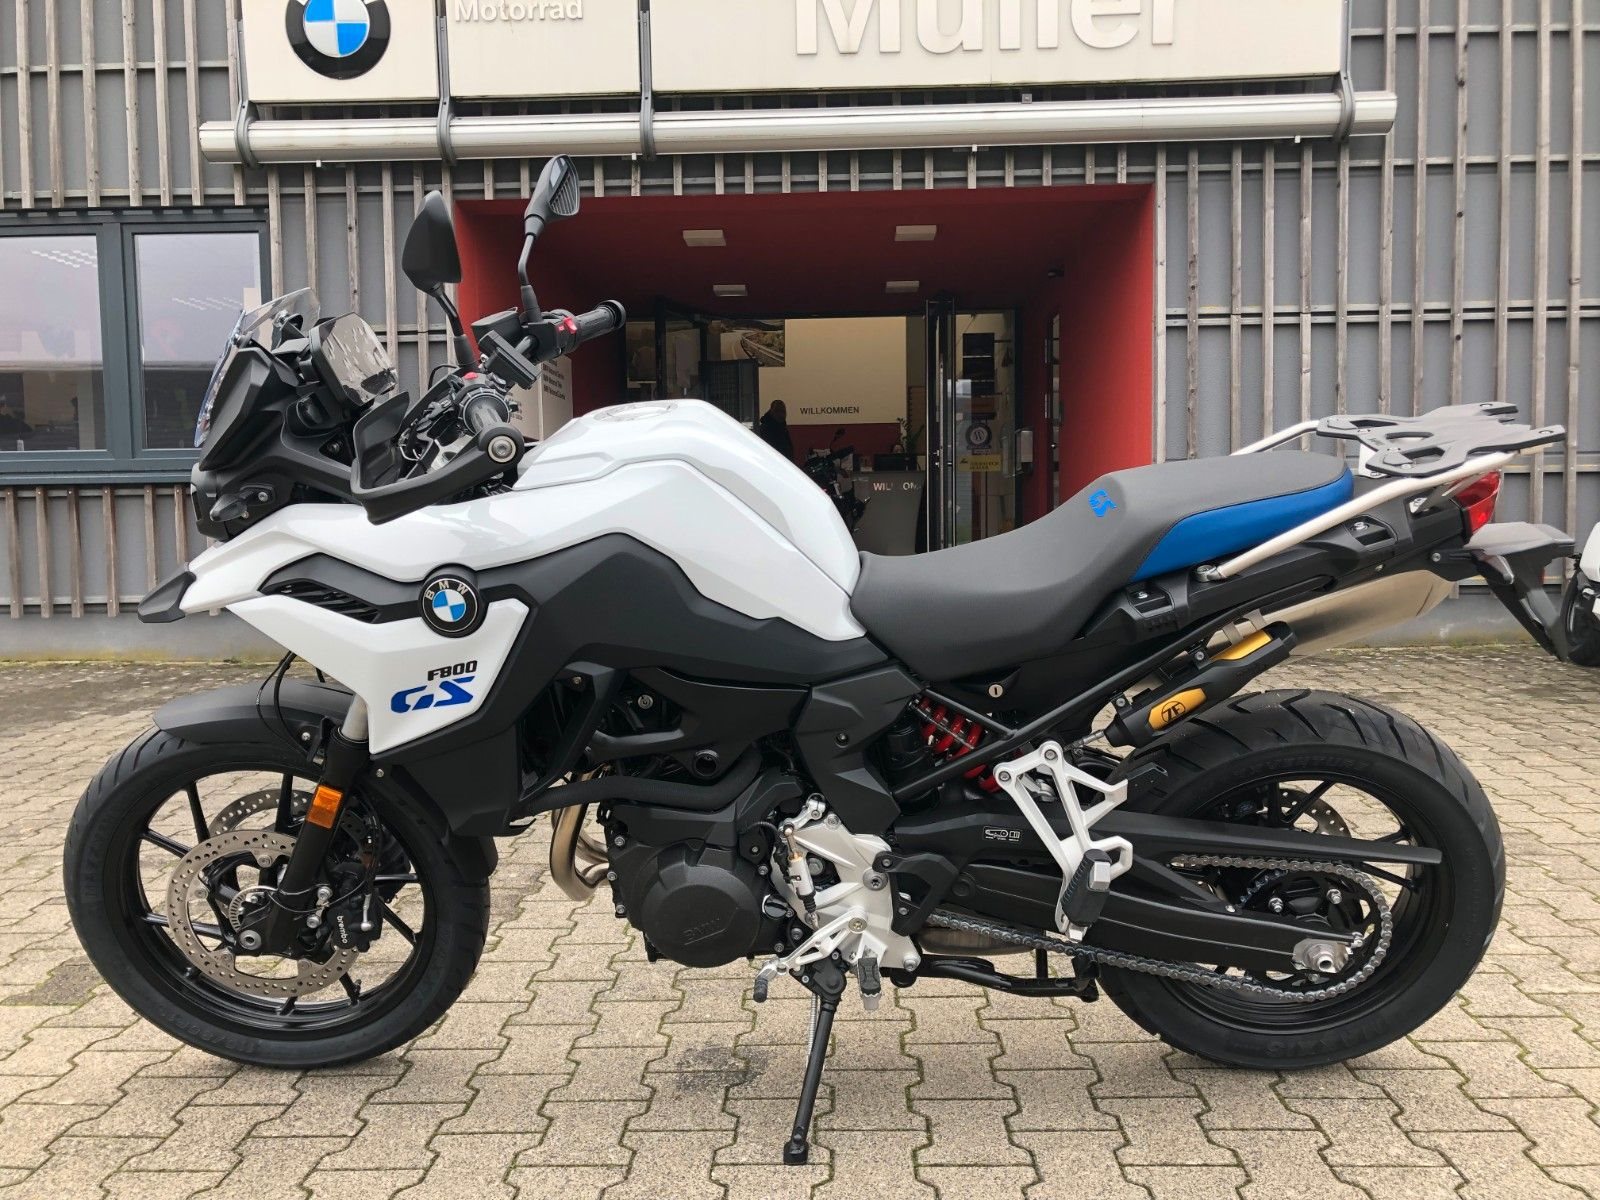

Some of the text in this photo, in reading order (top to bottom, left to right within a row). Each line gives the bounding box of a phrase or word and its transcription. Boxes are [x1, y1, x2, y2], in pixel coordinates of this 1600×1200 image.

[455, 0, 583, 22] Motorrad
[799, 406, 860, 415] WILLKOMMEN
[424, 580, 469, 600] BMW
[427, 660, 478, 681] F800
[390, 675, 476, 714] GS
[1162, 702, 1183, 721] ZF
[336, 915, 348, 944] brembo
